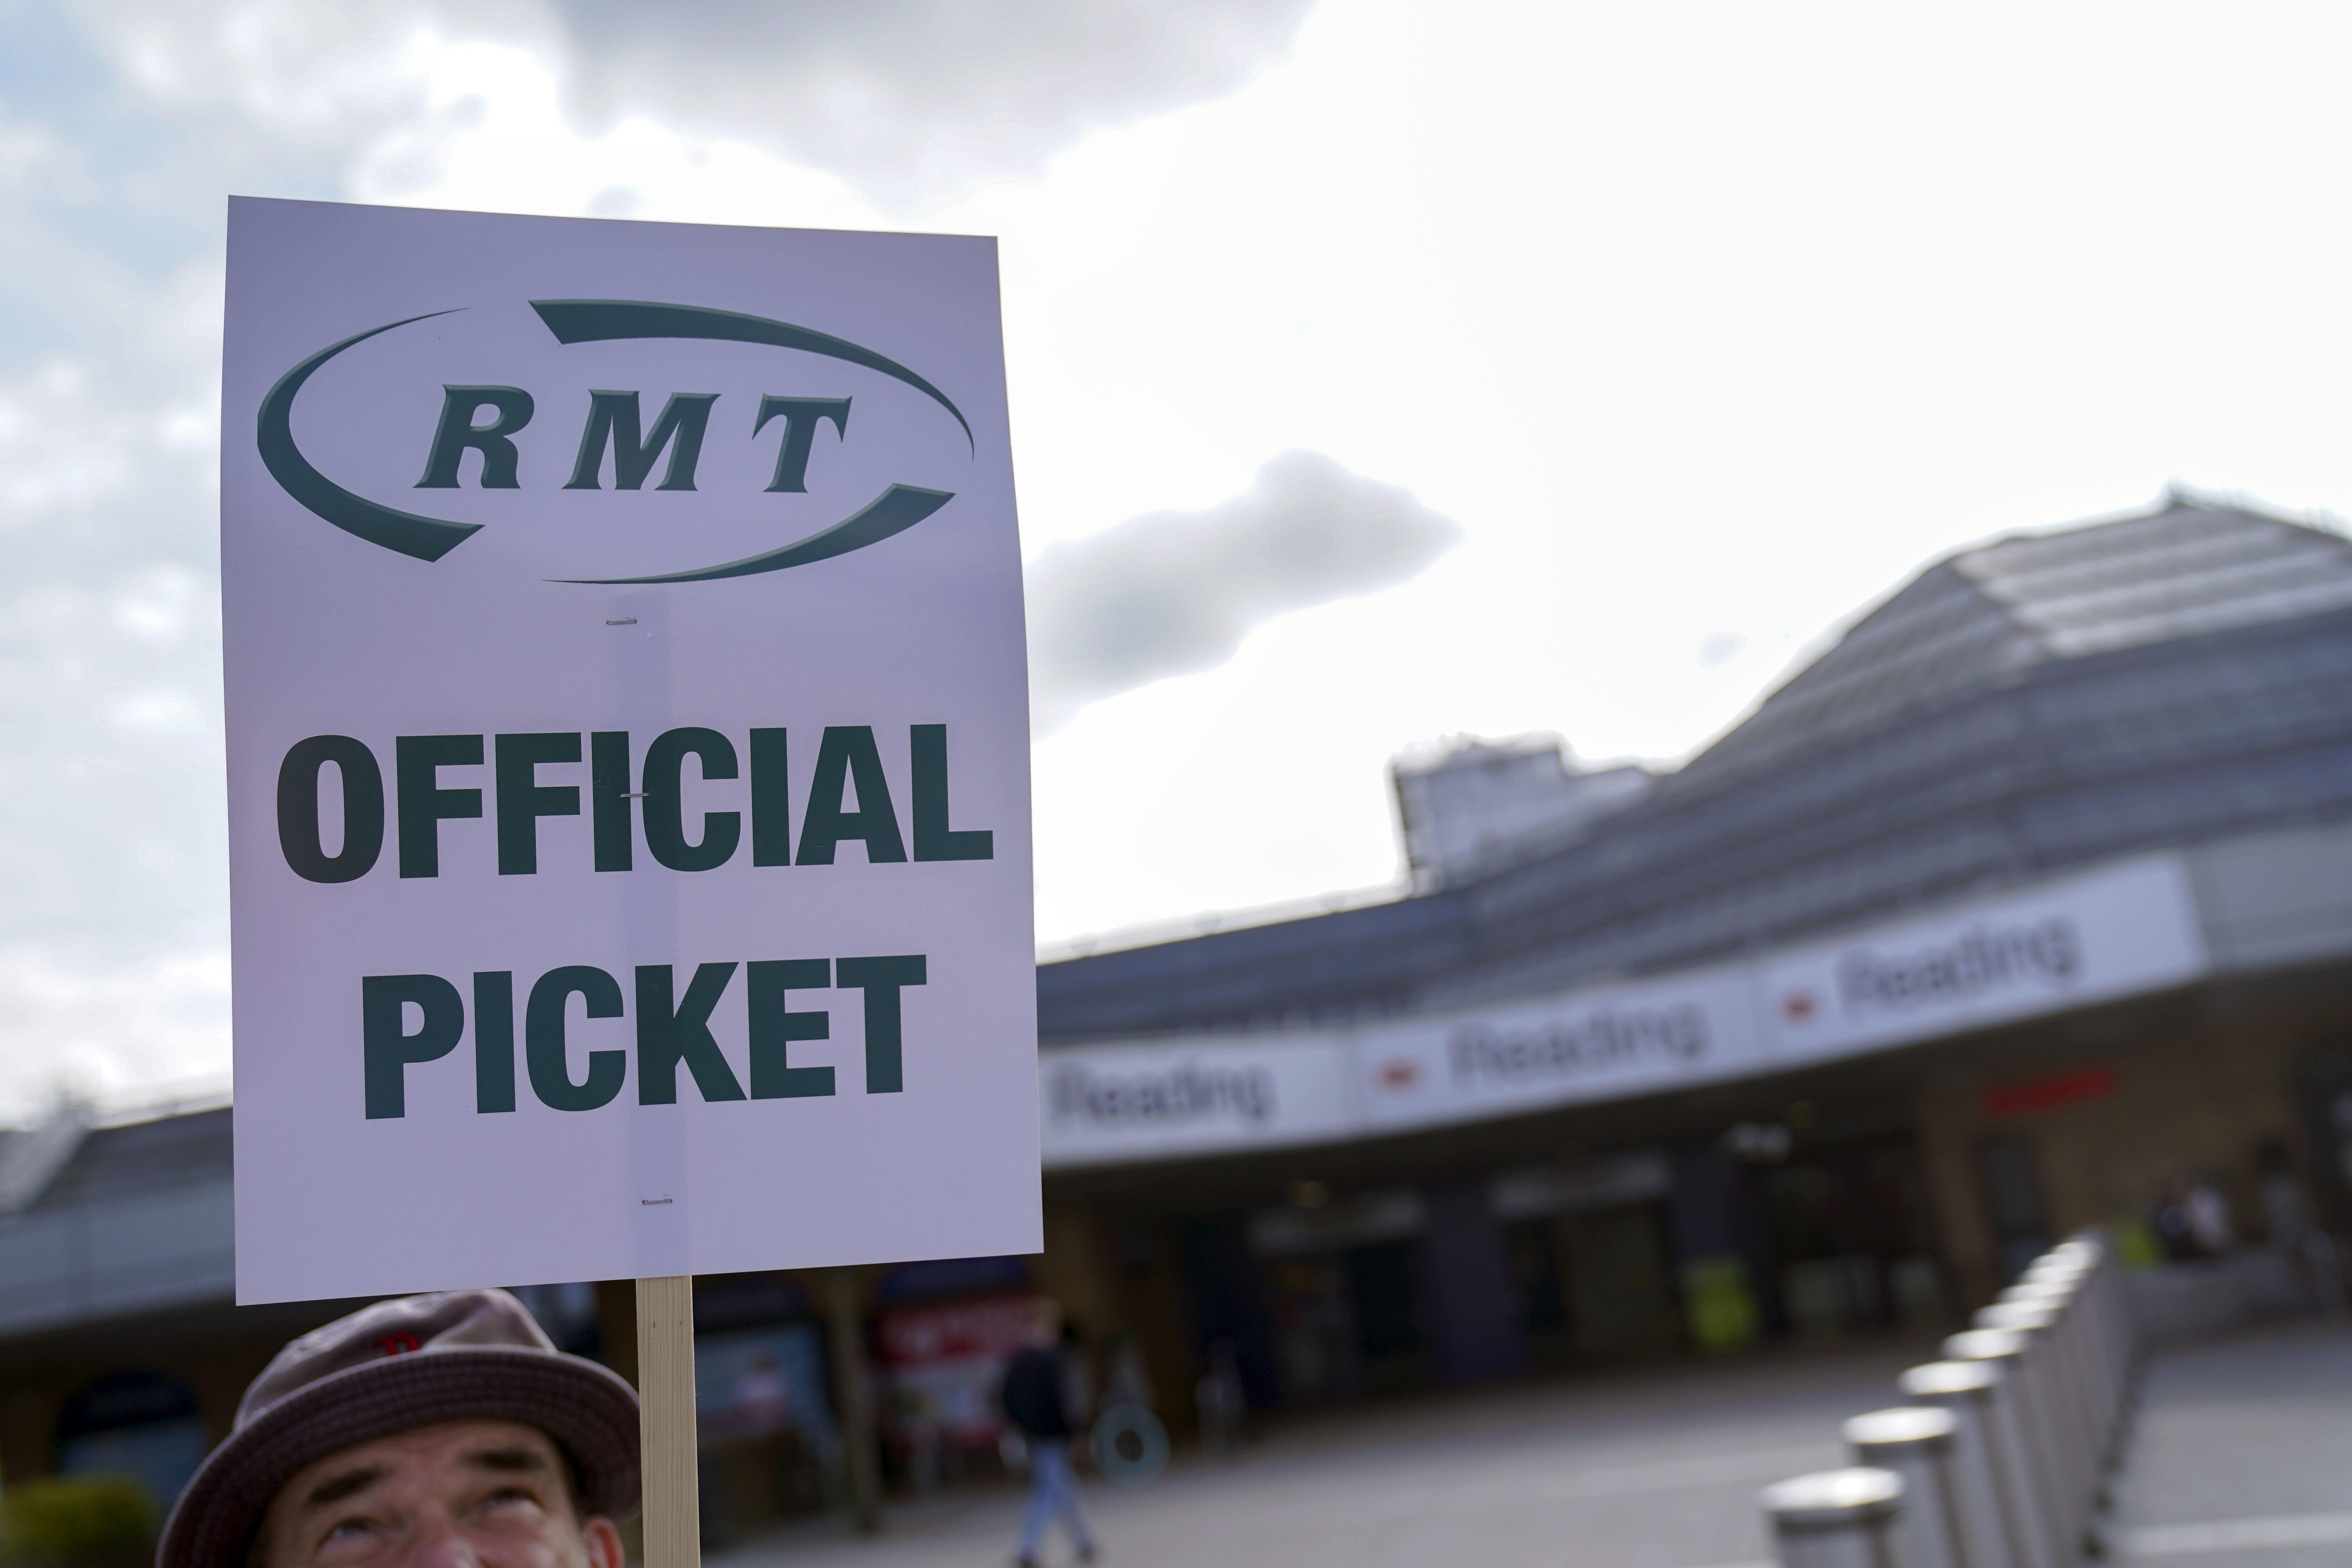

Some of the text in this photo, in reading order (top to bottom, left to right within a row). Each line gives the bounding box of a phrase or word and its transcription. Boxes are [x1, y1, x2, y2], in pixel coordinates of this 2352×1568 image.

[412, 384, 853, 493] RMT
[276, 724, 994, 884] OFFICIAL
[1834, 917, 2085, 1016] Reading
[361, 954, 927, 1120] PICKET
[1450, 1004, 1713, 1087] Reading
